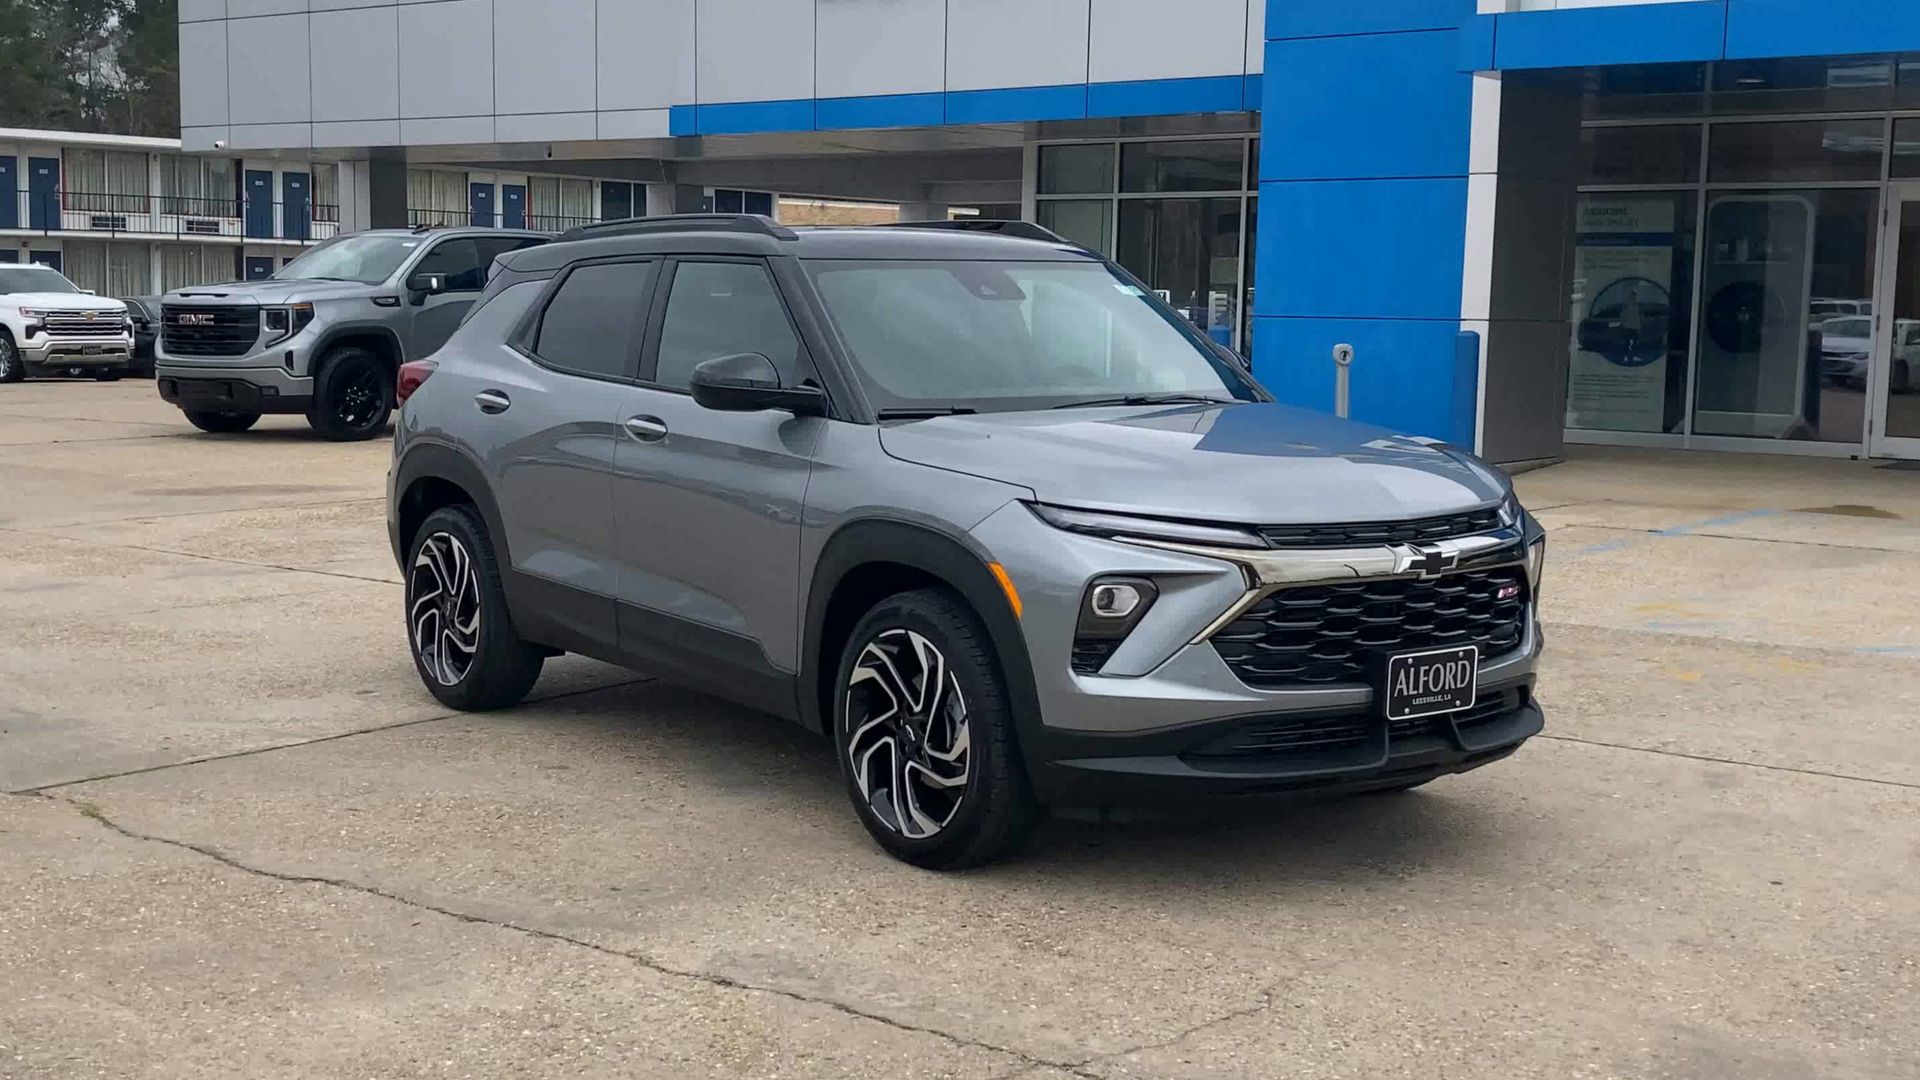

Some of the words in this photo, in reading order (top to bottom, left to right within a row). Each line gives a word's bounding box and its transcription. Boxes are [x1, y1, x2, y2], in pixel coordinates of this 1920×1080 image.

[178, 314, 214, 325] GMC
[1394, 660, 1471, 697] ALFORD
[1412, 695, 1443, 705] LEESVILLE,
